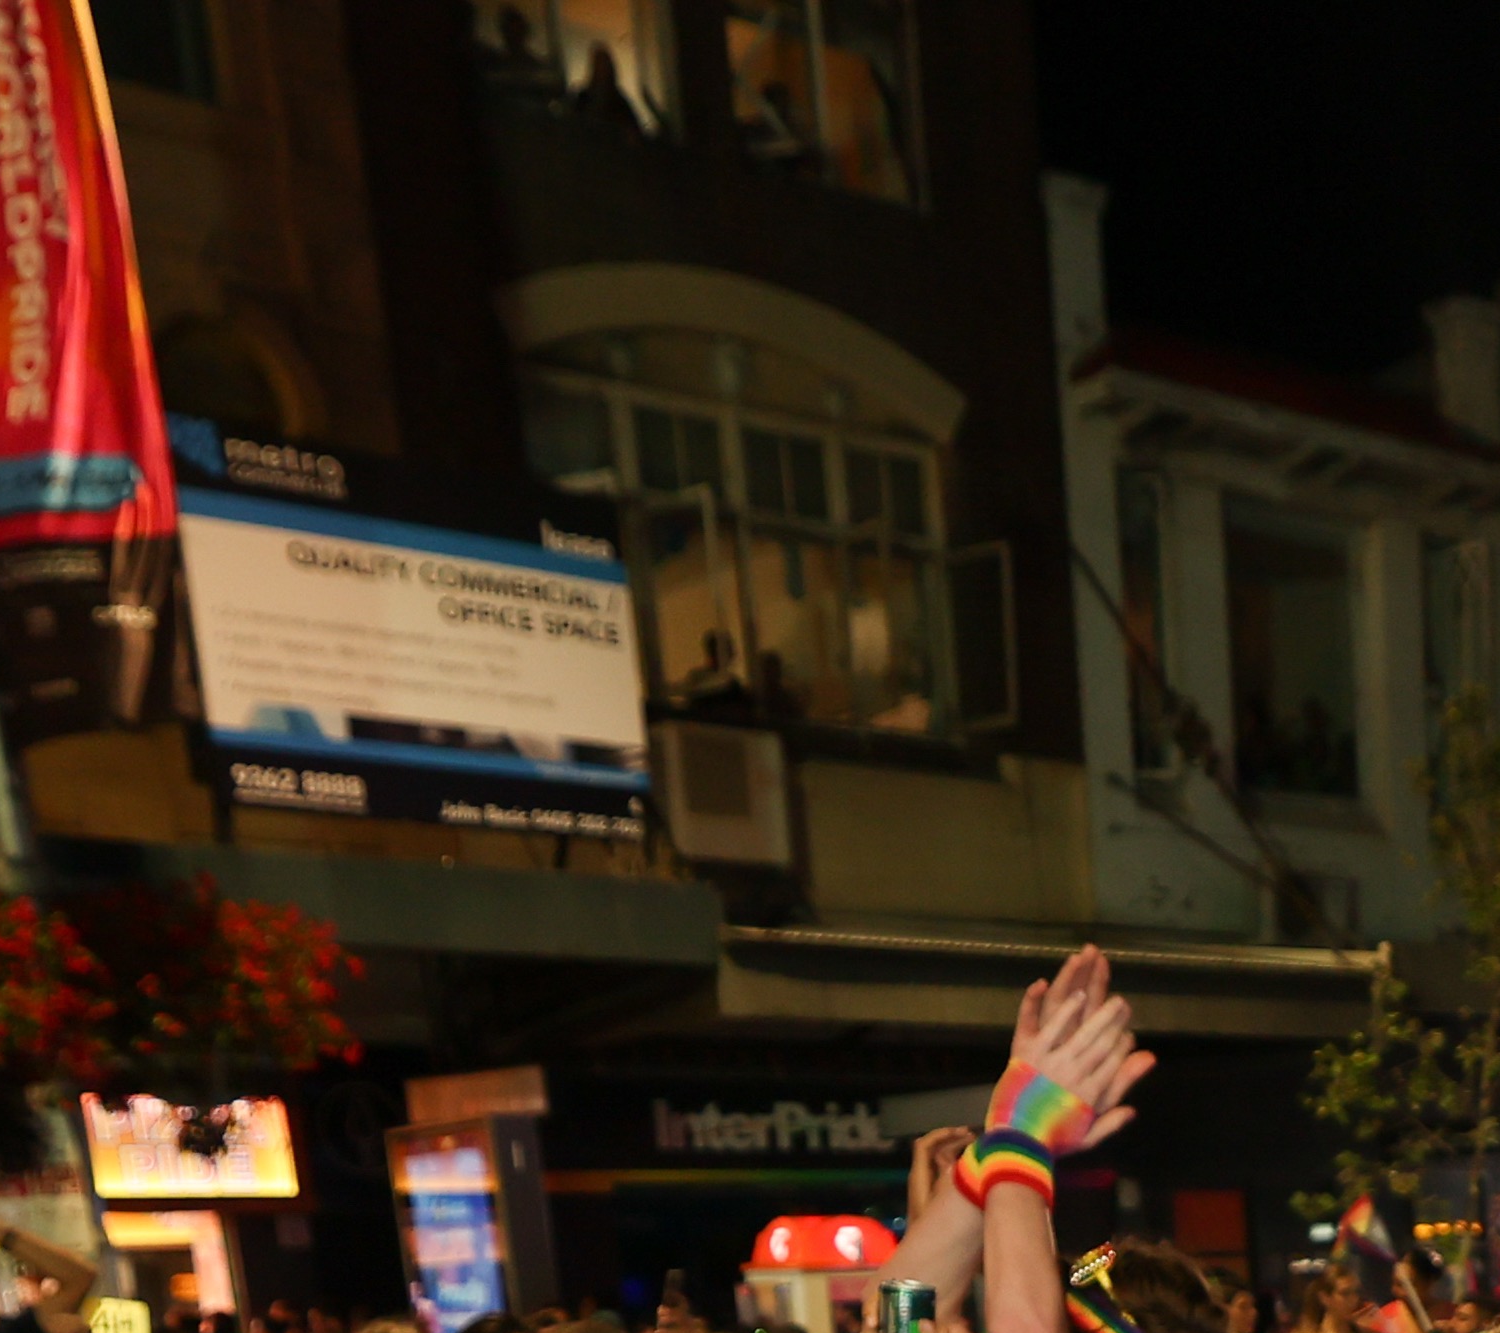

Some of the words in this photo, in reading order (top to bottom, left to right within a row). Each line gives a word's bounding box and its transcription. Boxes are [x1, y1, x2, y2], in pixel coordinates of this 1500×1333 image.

[287, 539, 411, 581] QUALITY
[418, 560, 600, 612] COMMERCIAL
[438, 594, 534, 632] OFFICE
[545, 610, 620, 645] SPACE
